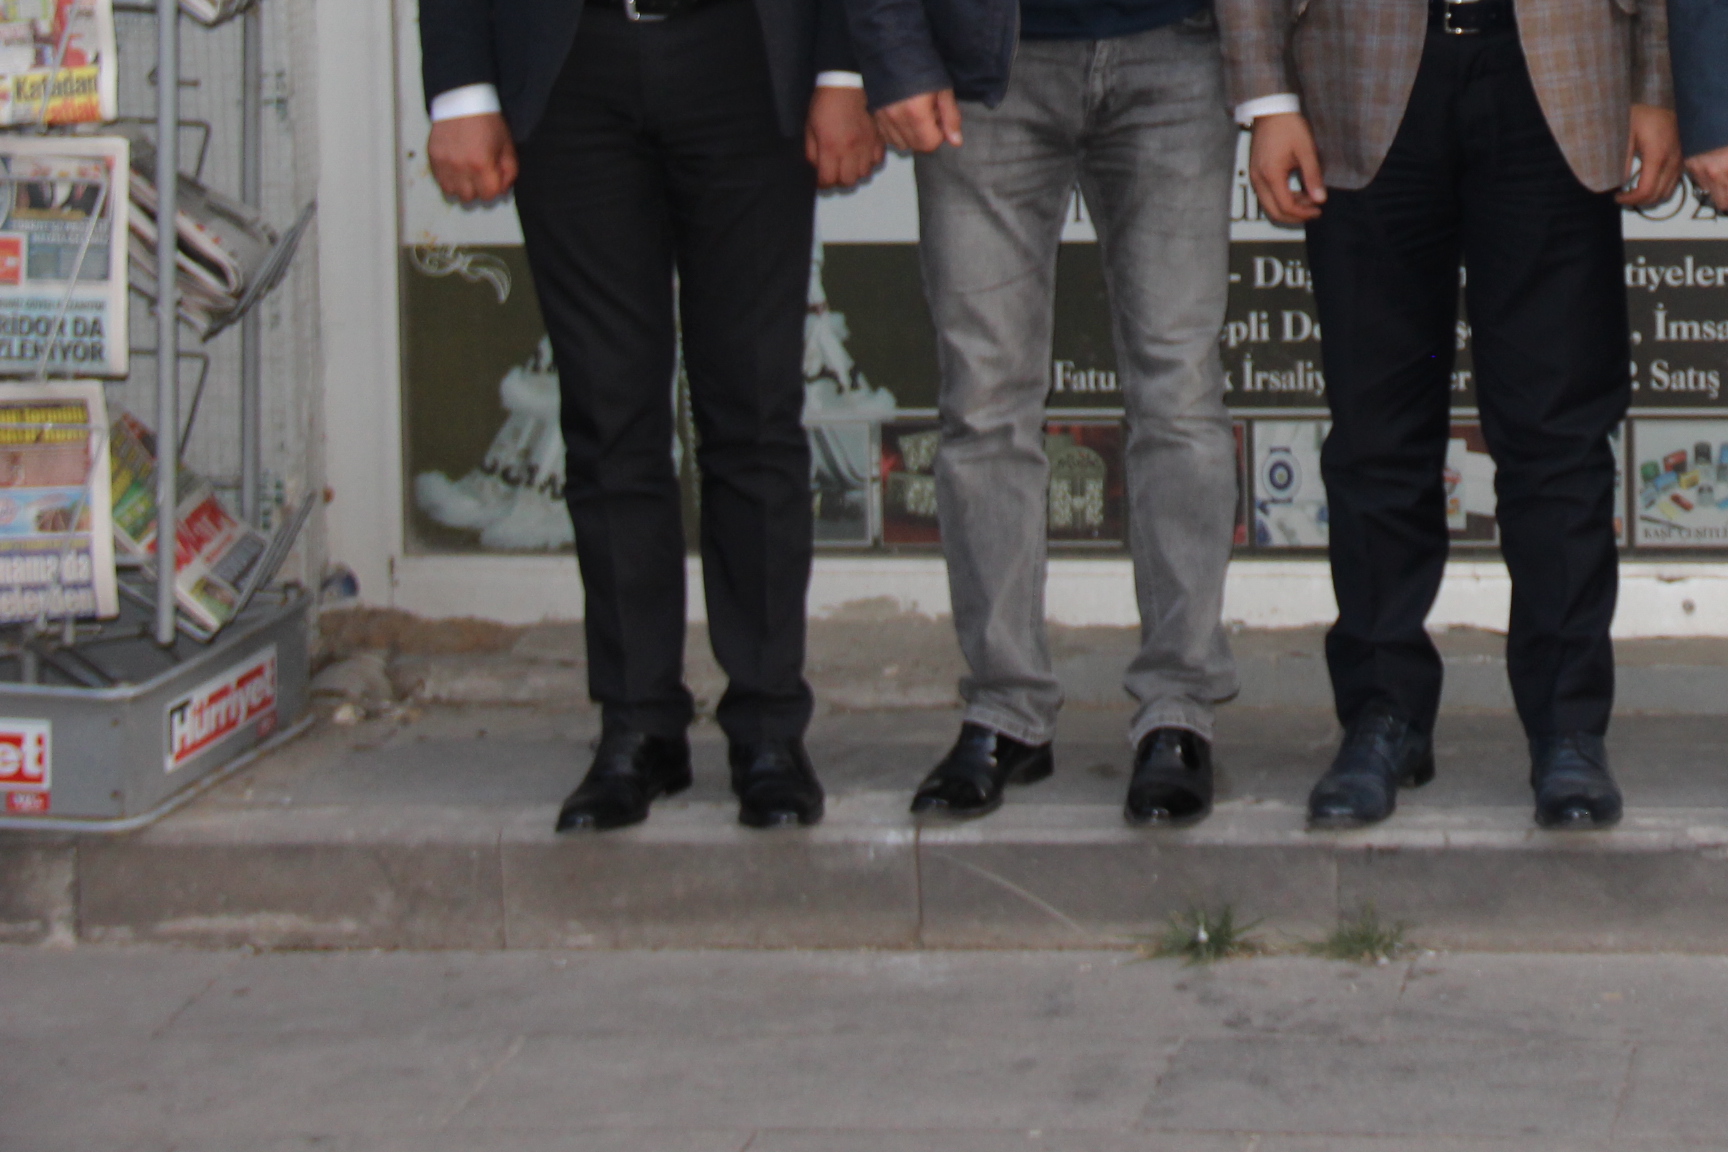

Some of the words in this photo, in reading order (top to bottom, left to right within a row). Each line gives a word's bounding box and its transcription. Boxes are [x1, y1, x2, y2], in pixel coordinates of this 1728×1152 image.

[1053, 359, 1120, 392] Fatu
[1649, 359, 1721, 400] Satış
[169, 655, 277, 764] Hürriyet
